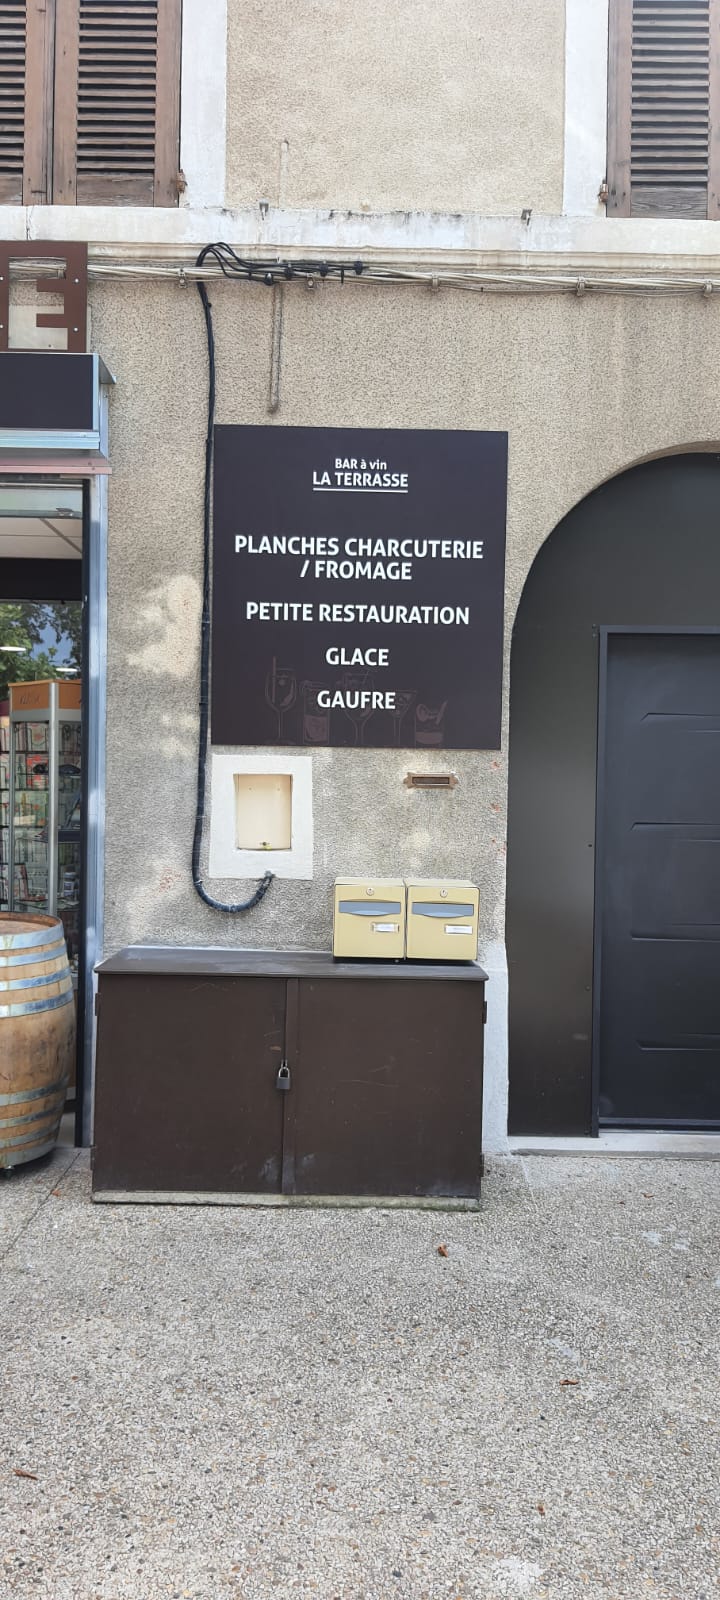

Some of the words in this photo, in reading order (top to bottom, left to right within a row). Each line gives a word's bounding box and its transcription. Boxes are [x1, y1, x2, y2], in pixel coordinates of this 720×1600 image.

[335, 458, 358, 470] BAR
[360, 458, 367, 470] à
[369, 458, 387, 471] vin
[313, 471, 331, 486] LA
[334, 472, 409, 487] TERRASSE
[235, 535, 339, 556] PLANCHES
[345, 538, 484, 559] CHARCUTERIE
[300, 560, 309, 578] /
[315, 560, 412, 580] FROMAGE
[246, 602, 313, 621] PETITE
[318, 603, 470, 625] RESTAURATION
[325, 648, 389, 667] GLACE
[317, 690, 396, 710] GAUFRE
